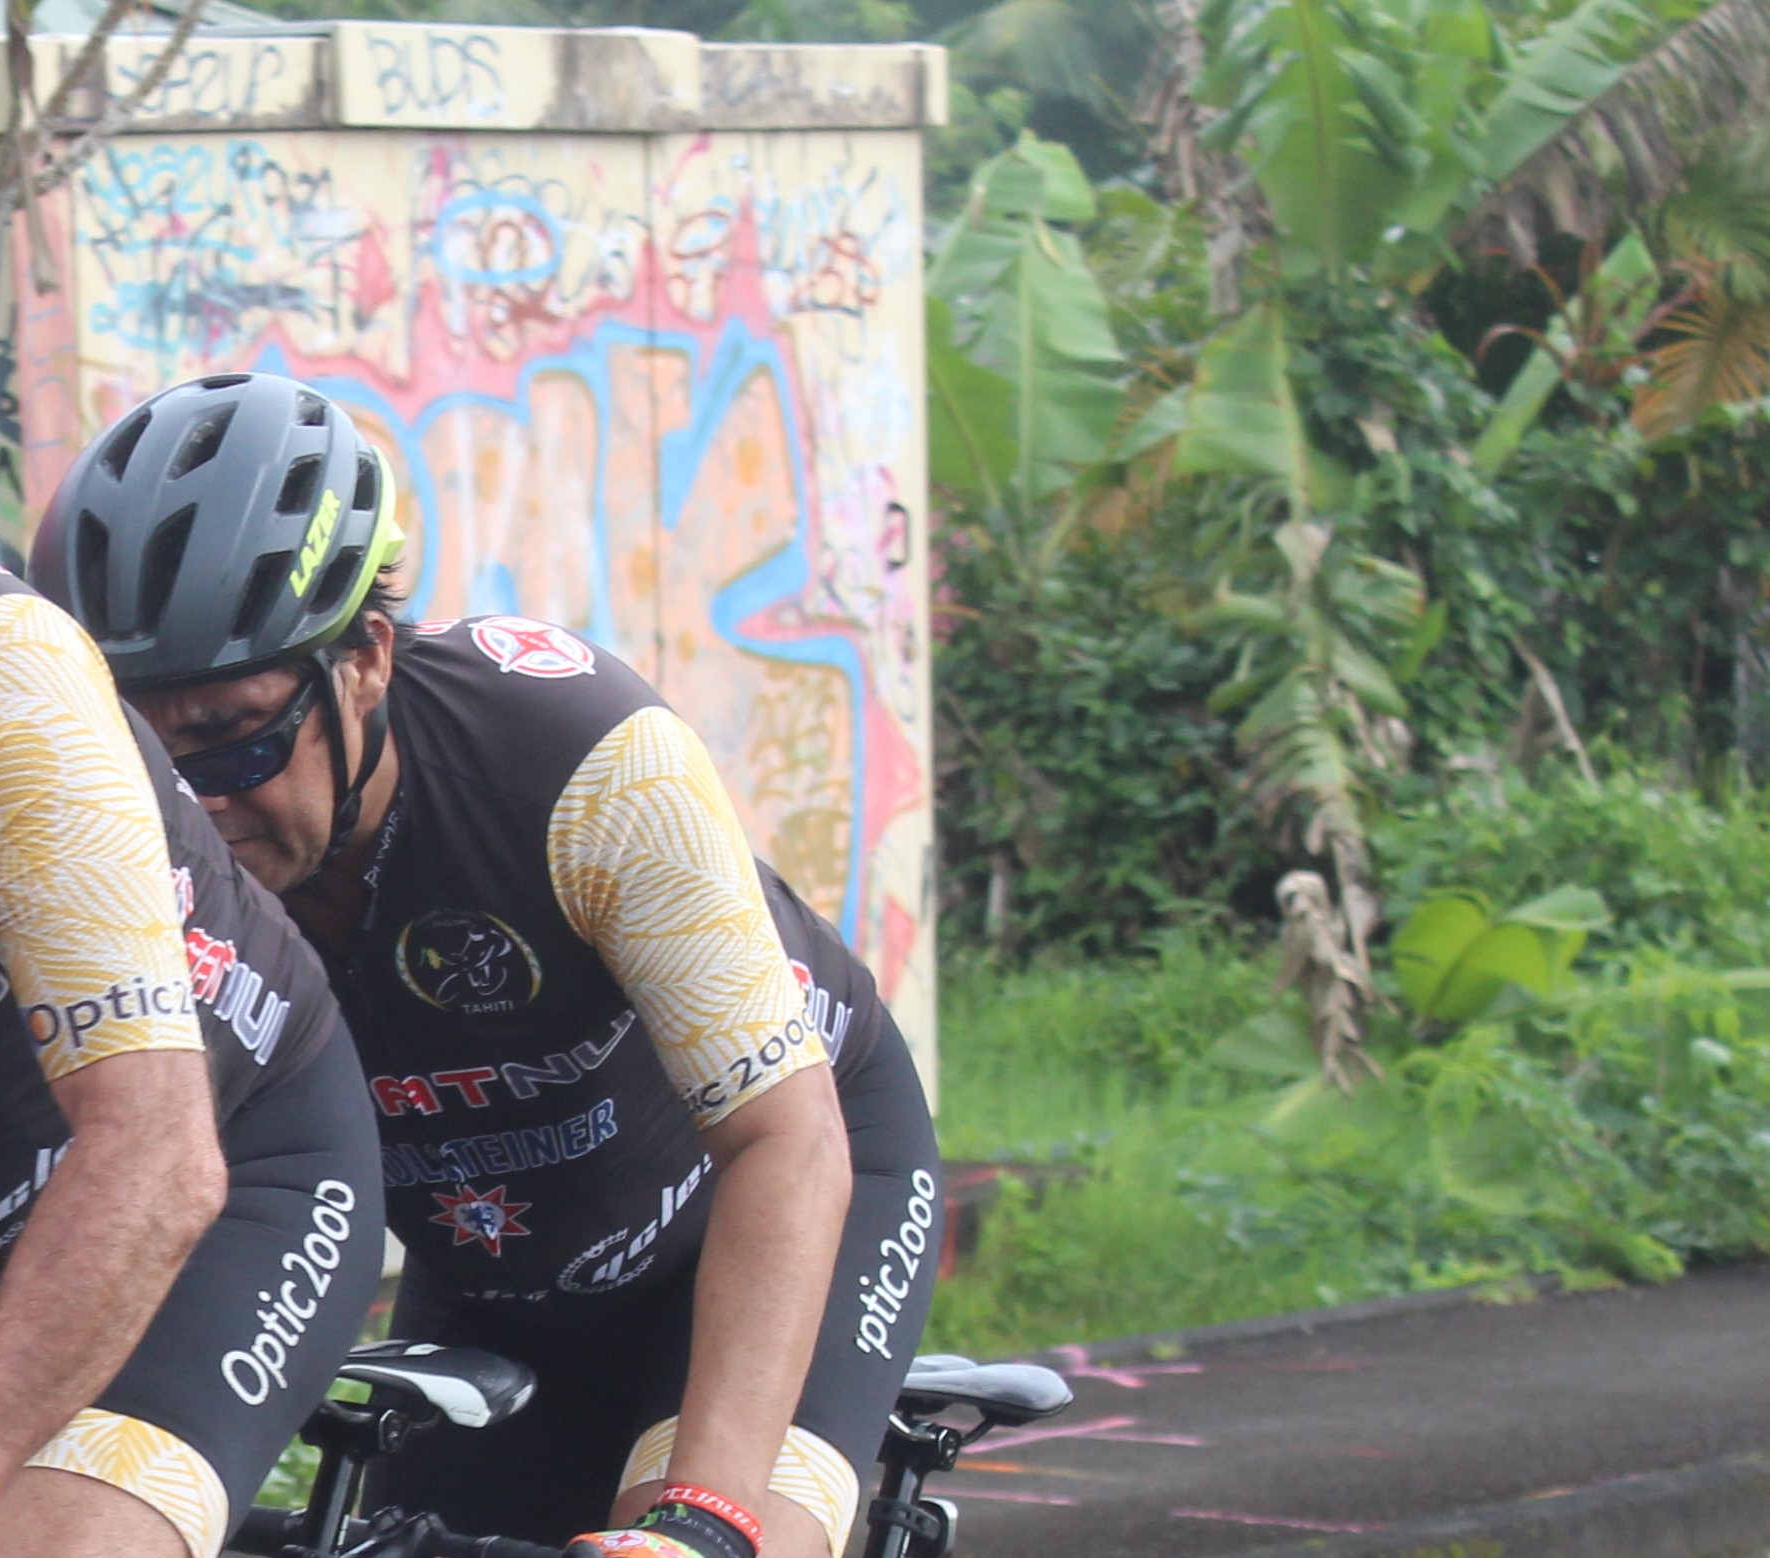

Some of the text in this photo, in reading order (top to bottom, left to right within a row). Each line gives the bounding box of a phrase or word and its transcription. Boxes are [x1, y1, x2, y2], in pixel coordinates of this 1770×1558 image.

[289, 488, 342, 598] LAZER
[461, 999, 515, 1017] TAHITI
[221, 1179, 356, 1406] Optic2000
[854, 1168, 936, 1360] ptic2000
